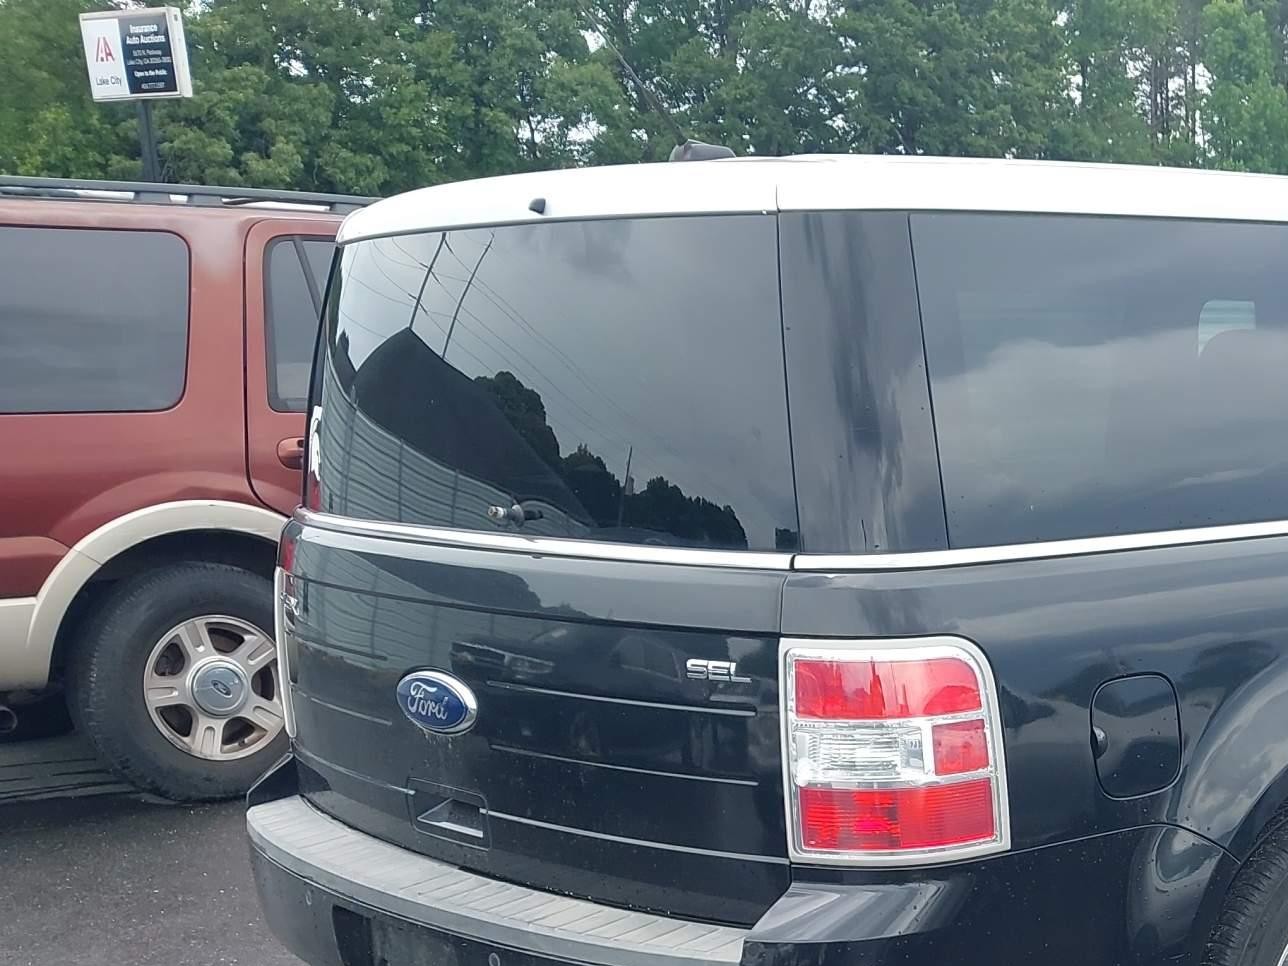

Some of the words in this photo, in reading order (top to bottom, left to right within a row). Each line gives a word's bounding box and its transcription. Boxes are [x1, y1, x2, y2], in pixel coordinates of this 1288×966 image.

[129, 24, 158, 34] Insurance
[126, 36, 139, 45] Auto
[140, 33, 166, 44] Auctions
[96, 77, 109, 86] Lake
[110, 75, 122, 87] City
[686, 659, 752, 683] SEL
[407, 681, 449, 720] Ford
